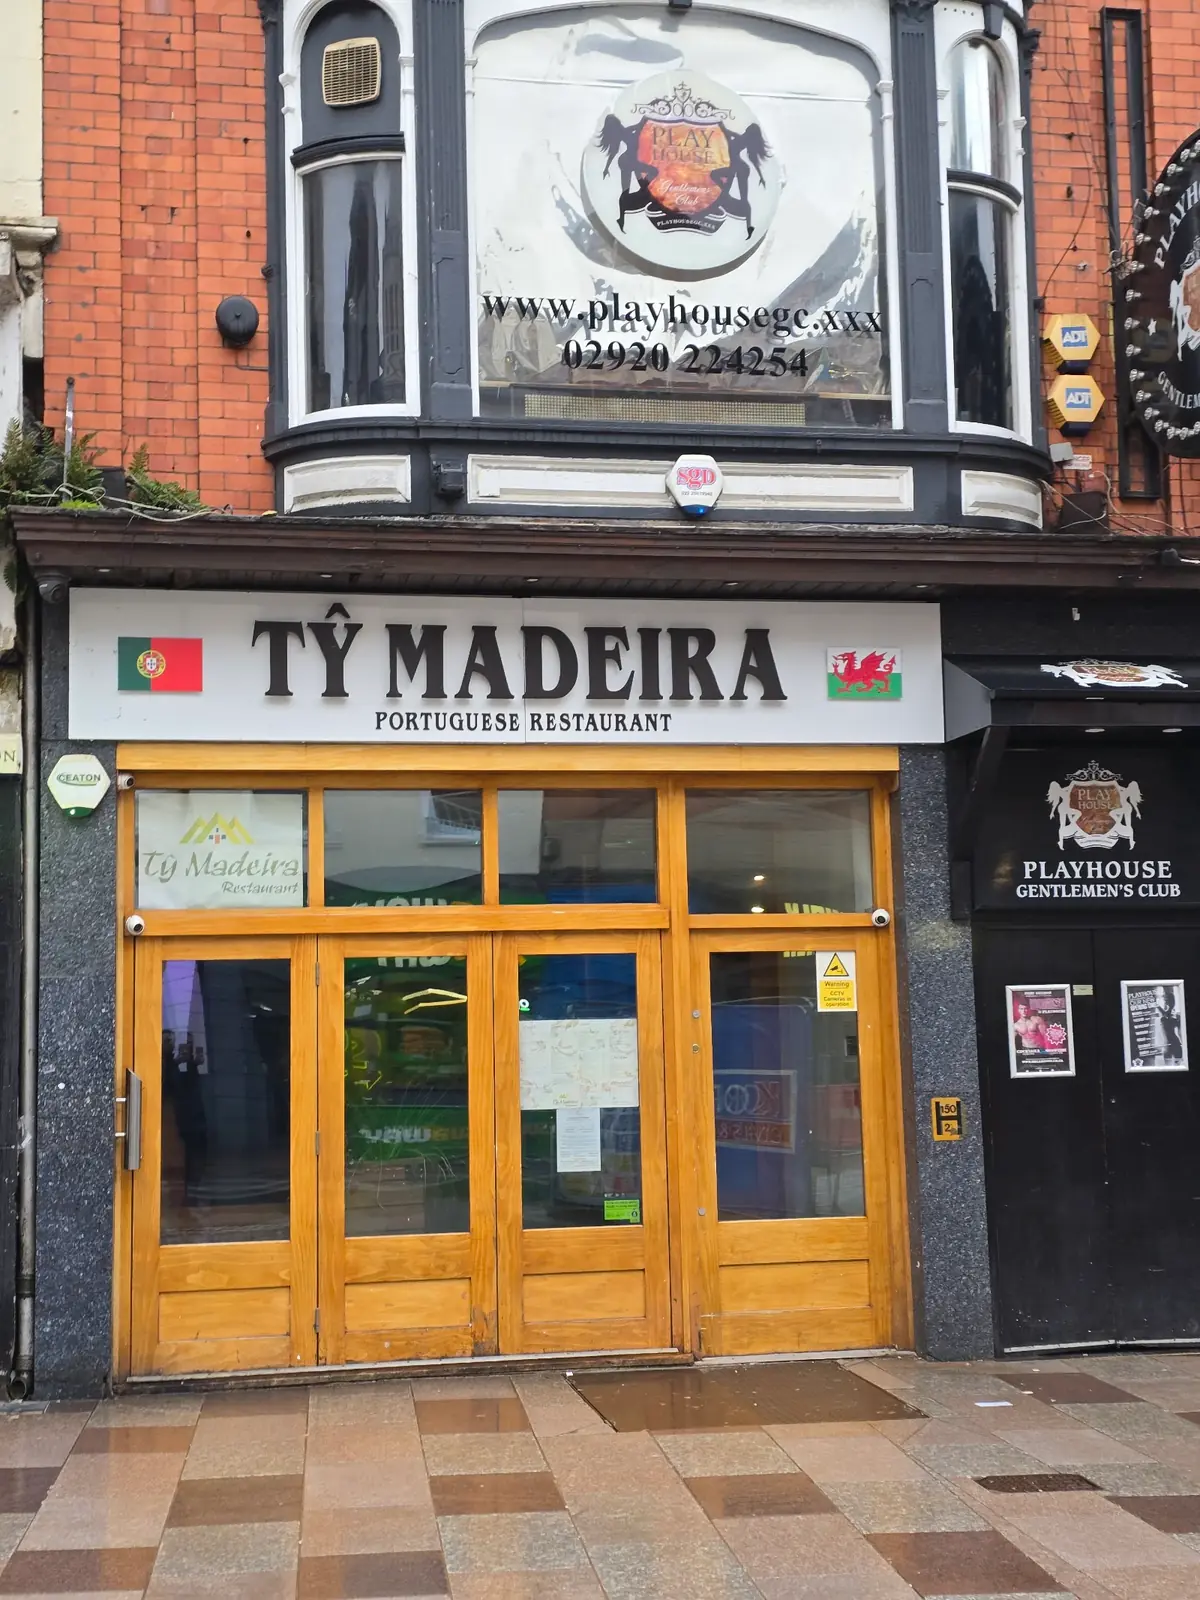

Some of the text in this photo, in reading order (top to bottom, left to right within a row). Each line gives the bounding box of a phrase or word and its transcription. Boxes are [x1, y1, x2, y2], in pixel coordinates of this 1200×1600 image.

[652, 127, 715, 148] PLAY
[652, 147, 715, 164] HOUSE
[675, 193, 699, 206] Club
[481, 293, 883, 337] www.playhousegc.xxx
[1063, 330, 1087, 343] ADT
[563, 339, 809, 377] 02920 224254
[1066, 392, 1091, 405] ADT
[251, 602, 788, 700] TŶ MADEIRA
[375, 711, 672, 733] PORTUGUESE RESTAURANT
[57, 771, 101, 783] CEATON
[1078, 789, 1111, 800] PLAY
[1078, 801, 1115, 810] HOUSE
[185, 850, 300, 877] Madeira
[1023, 860, 1172, 879] PLAYHOUSE
[222, 881, 299, 894] Restaurant
[1016, 883, 1181, 898] GENTLEMEN'S CLUB
[941, 1104, 957, 1114] 150
